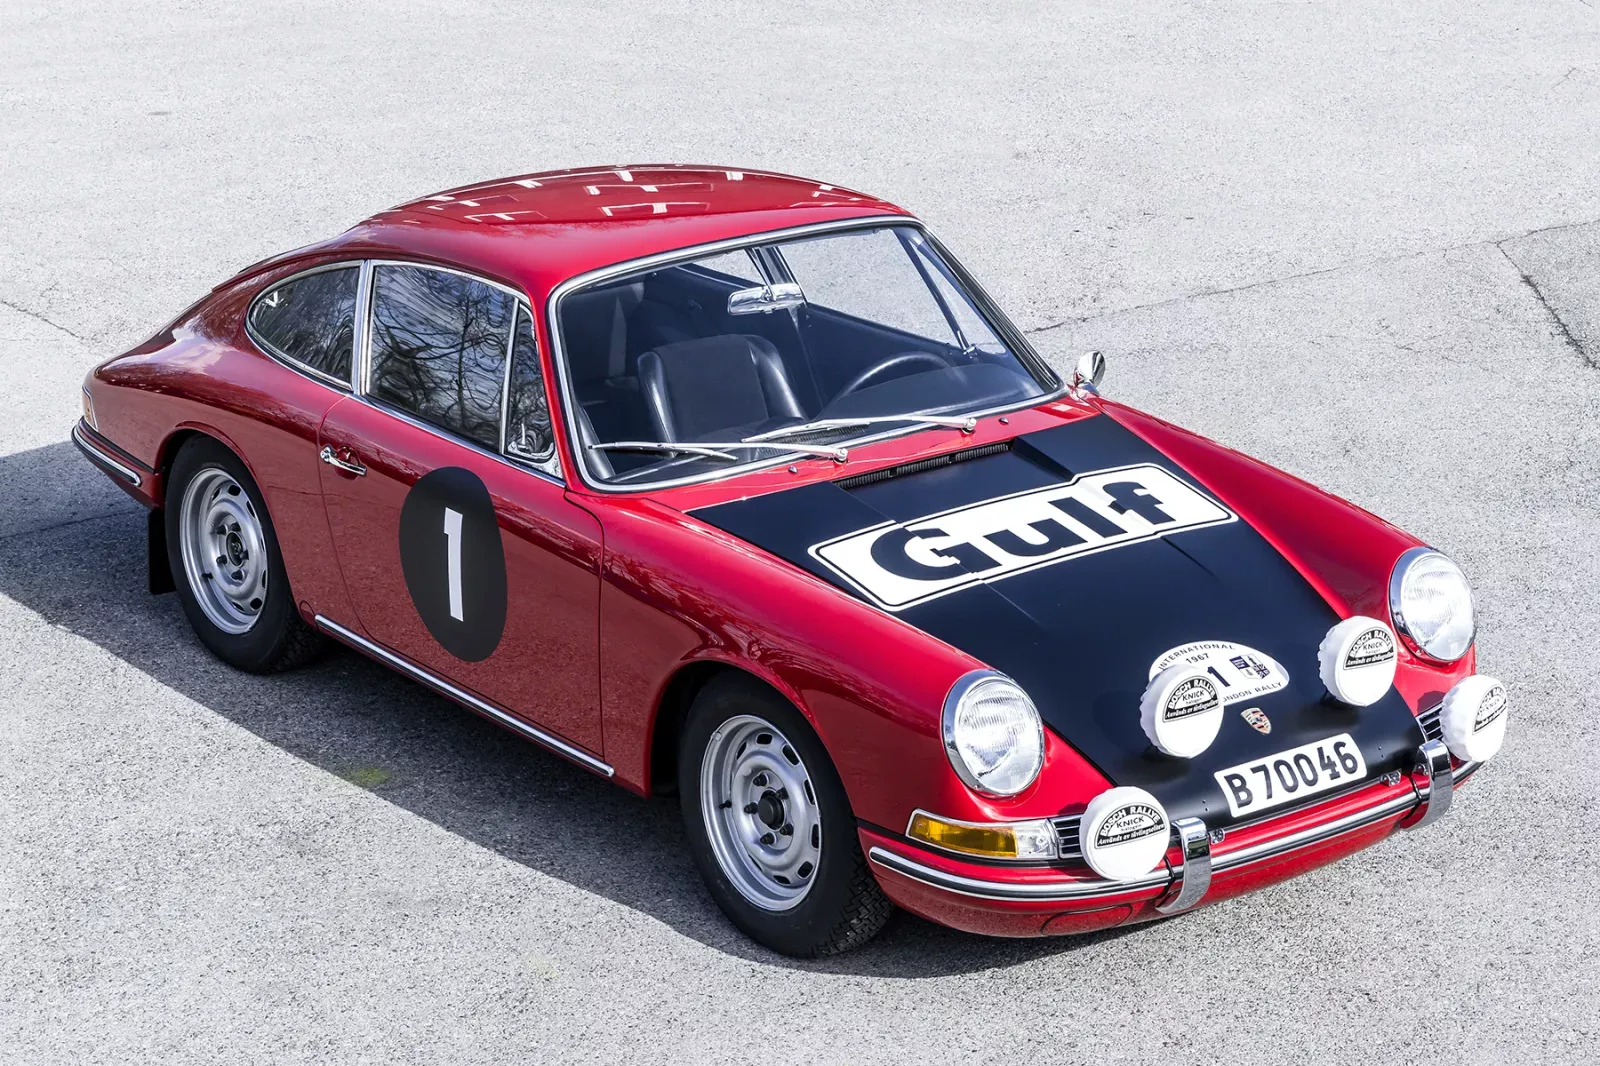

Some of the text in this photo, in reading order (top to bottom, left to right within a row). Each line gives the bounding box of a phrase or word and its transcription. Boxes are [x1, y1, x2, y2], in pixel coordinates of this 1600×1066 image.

[870, 481, 1176, 581] Gulf
[444, 507, 464, 622] 1
[1363, 641, 1383, 651] KNICK
[1158, 643, 1236, 671] INTERNATIONAL
[1185, 652, 1210, 664] 1967
[1207, 666, 1231, 687] 1
[1167, 682, 1192, 709] BOSCH
[1182, 690, 1204, 701] KNICK
[1256, 682, 1282, 693] RALLY
[1100, 806, 1161, 836] BOSCH RALLYE
[1116, 816, 1144, 828] KNICK
